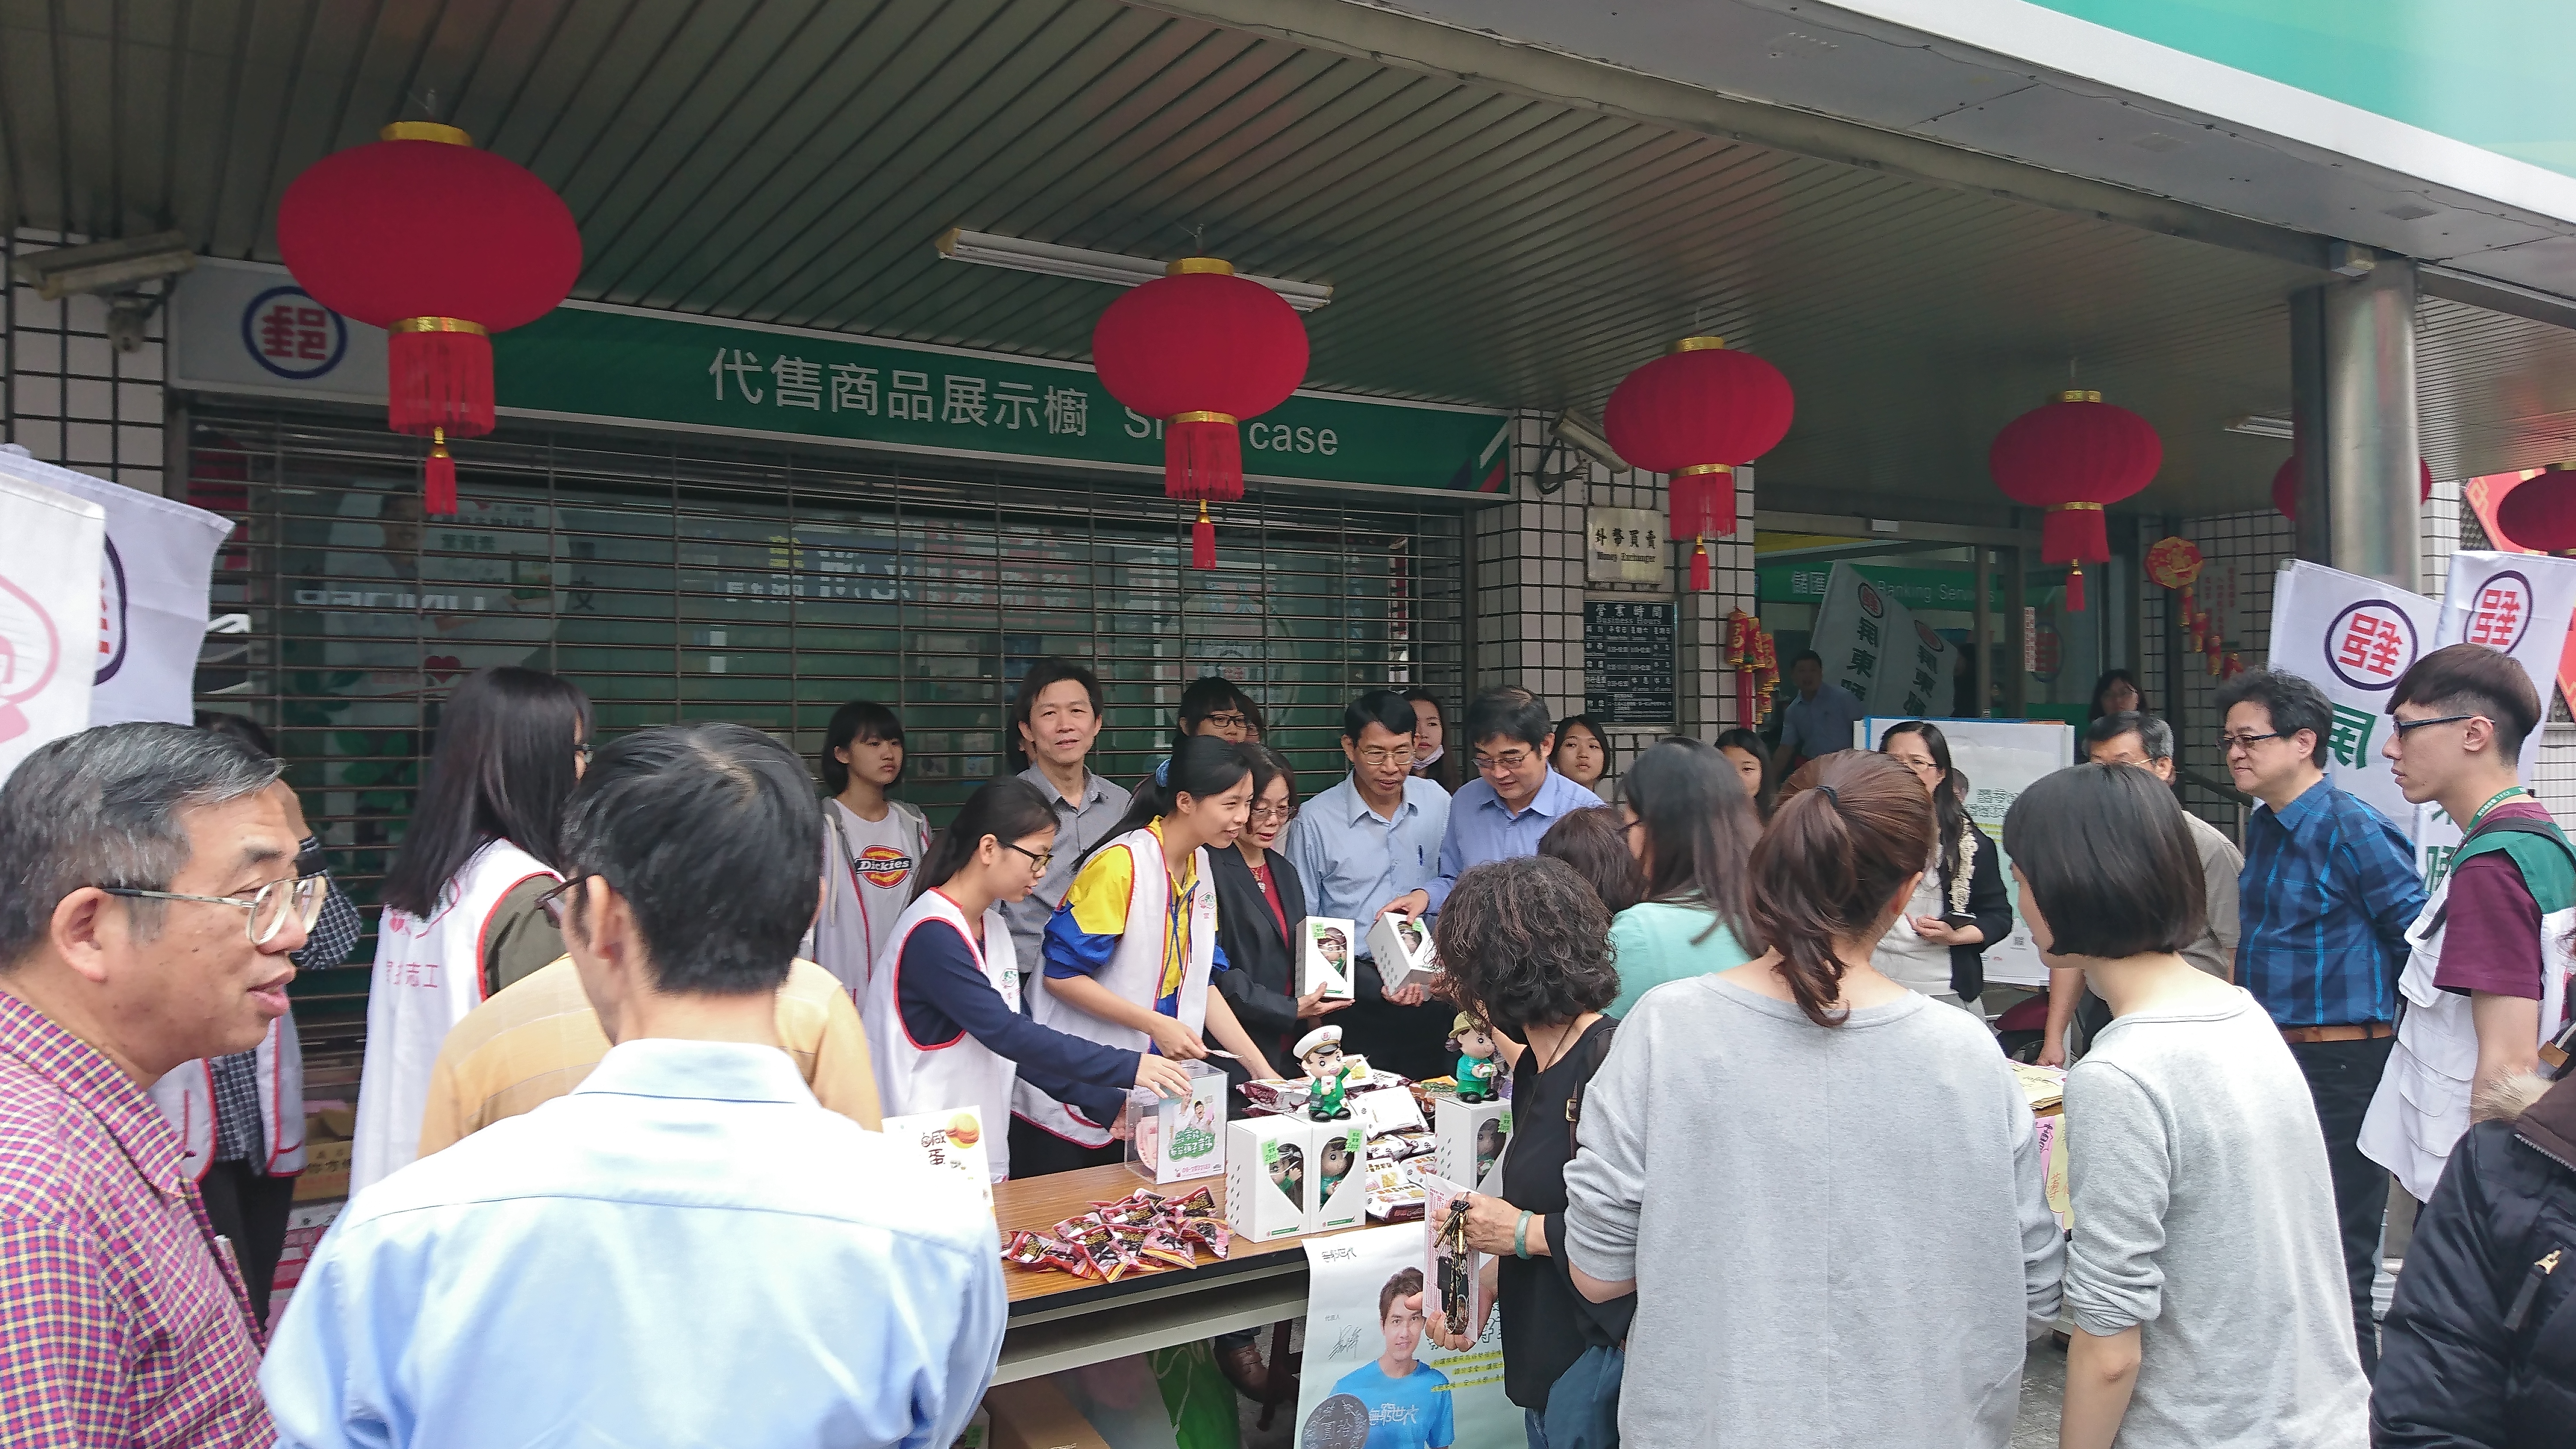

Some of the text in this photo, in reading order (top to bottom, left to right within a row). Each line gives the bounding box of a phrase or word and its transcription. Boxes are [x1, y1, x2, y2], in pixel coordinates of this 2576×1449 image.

[263, 304, 327, 361] 郵
[708, 347, 1088, 437] 代售商品展示櫥
[1595, 604, 1663, 618] 營業時間
[857, 860, 910, 870] Dickies
